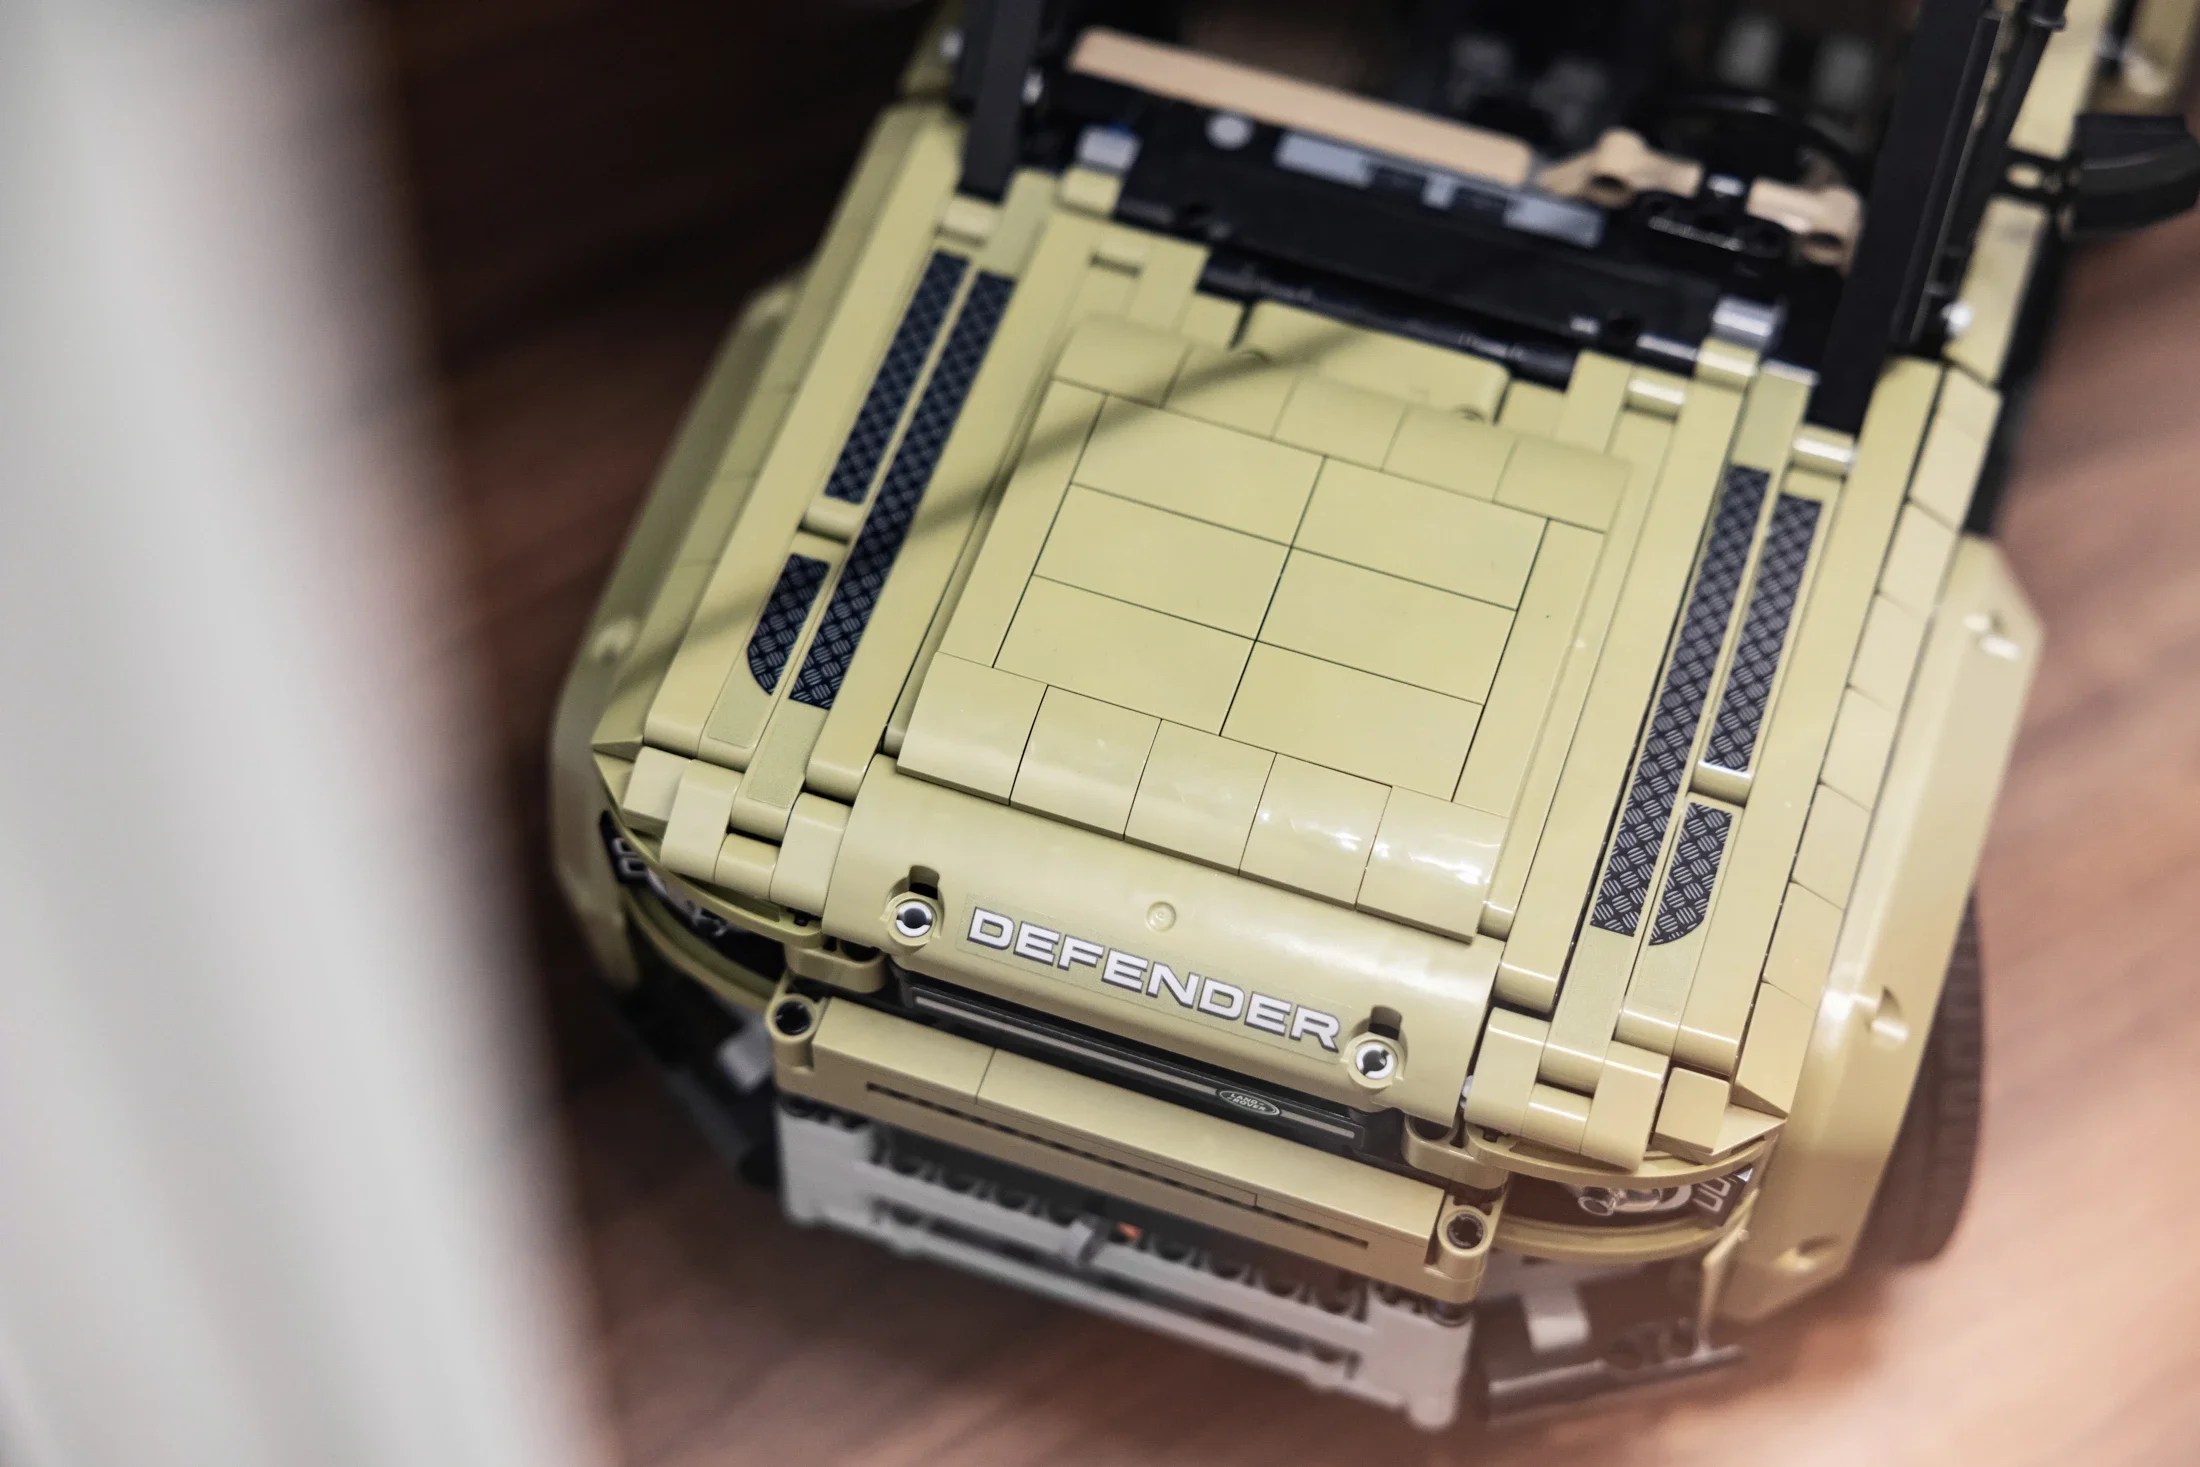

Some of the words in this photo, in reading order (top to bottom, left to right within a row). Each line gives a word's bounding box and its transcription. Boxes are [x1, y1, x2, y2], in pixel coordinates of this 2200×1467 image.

[967, 906, 1341, 1052] DEFENDER
[1231, 1093, 1258, 1106] LAND
[1232, 1098, 1266, 1111] ROVER
